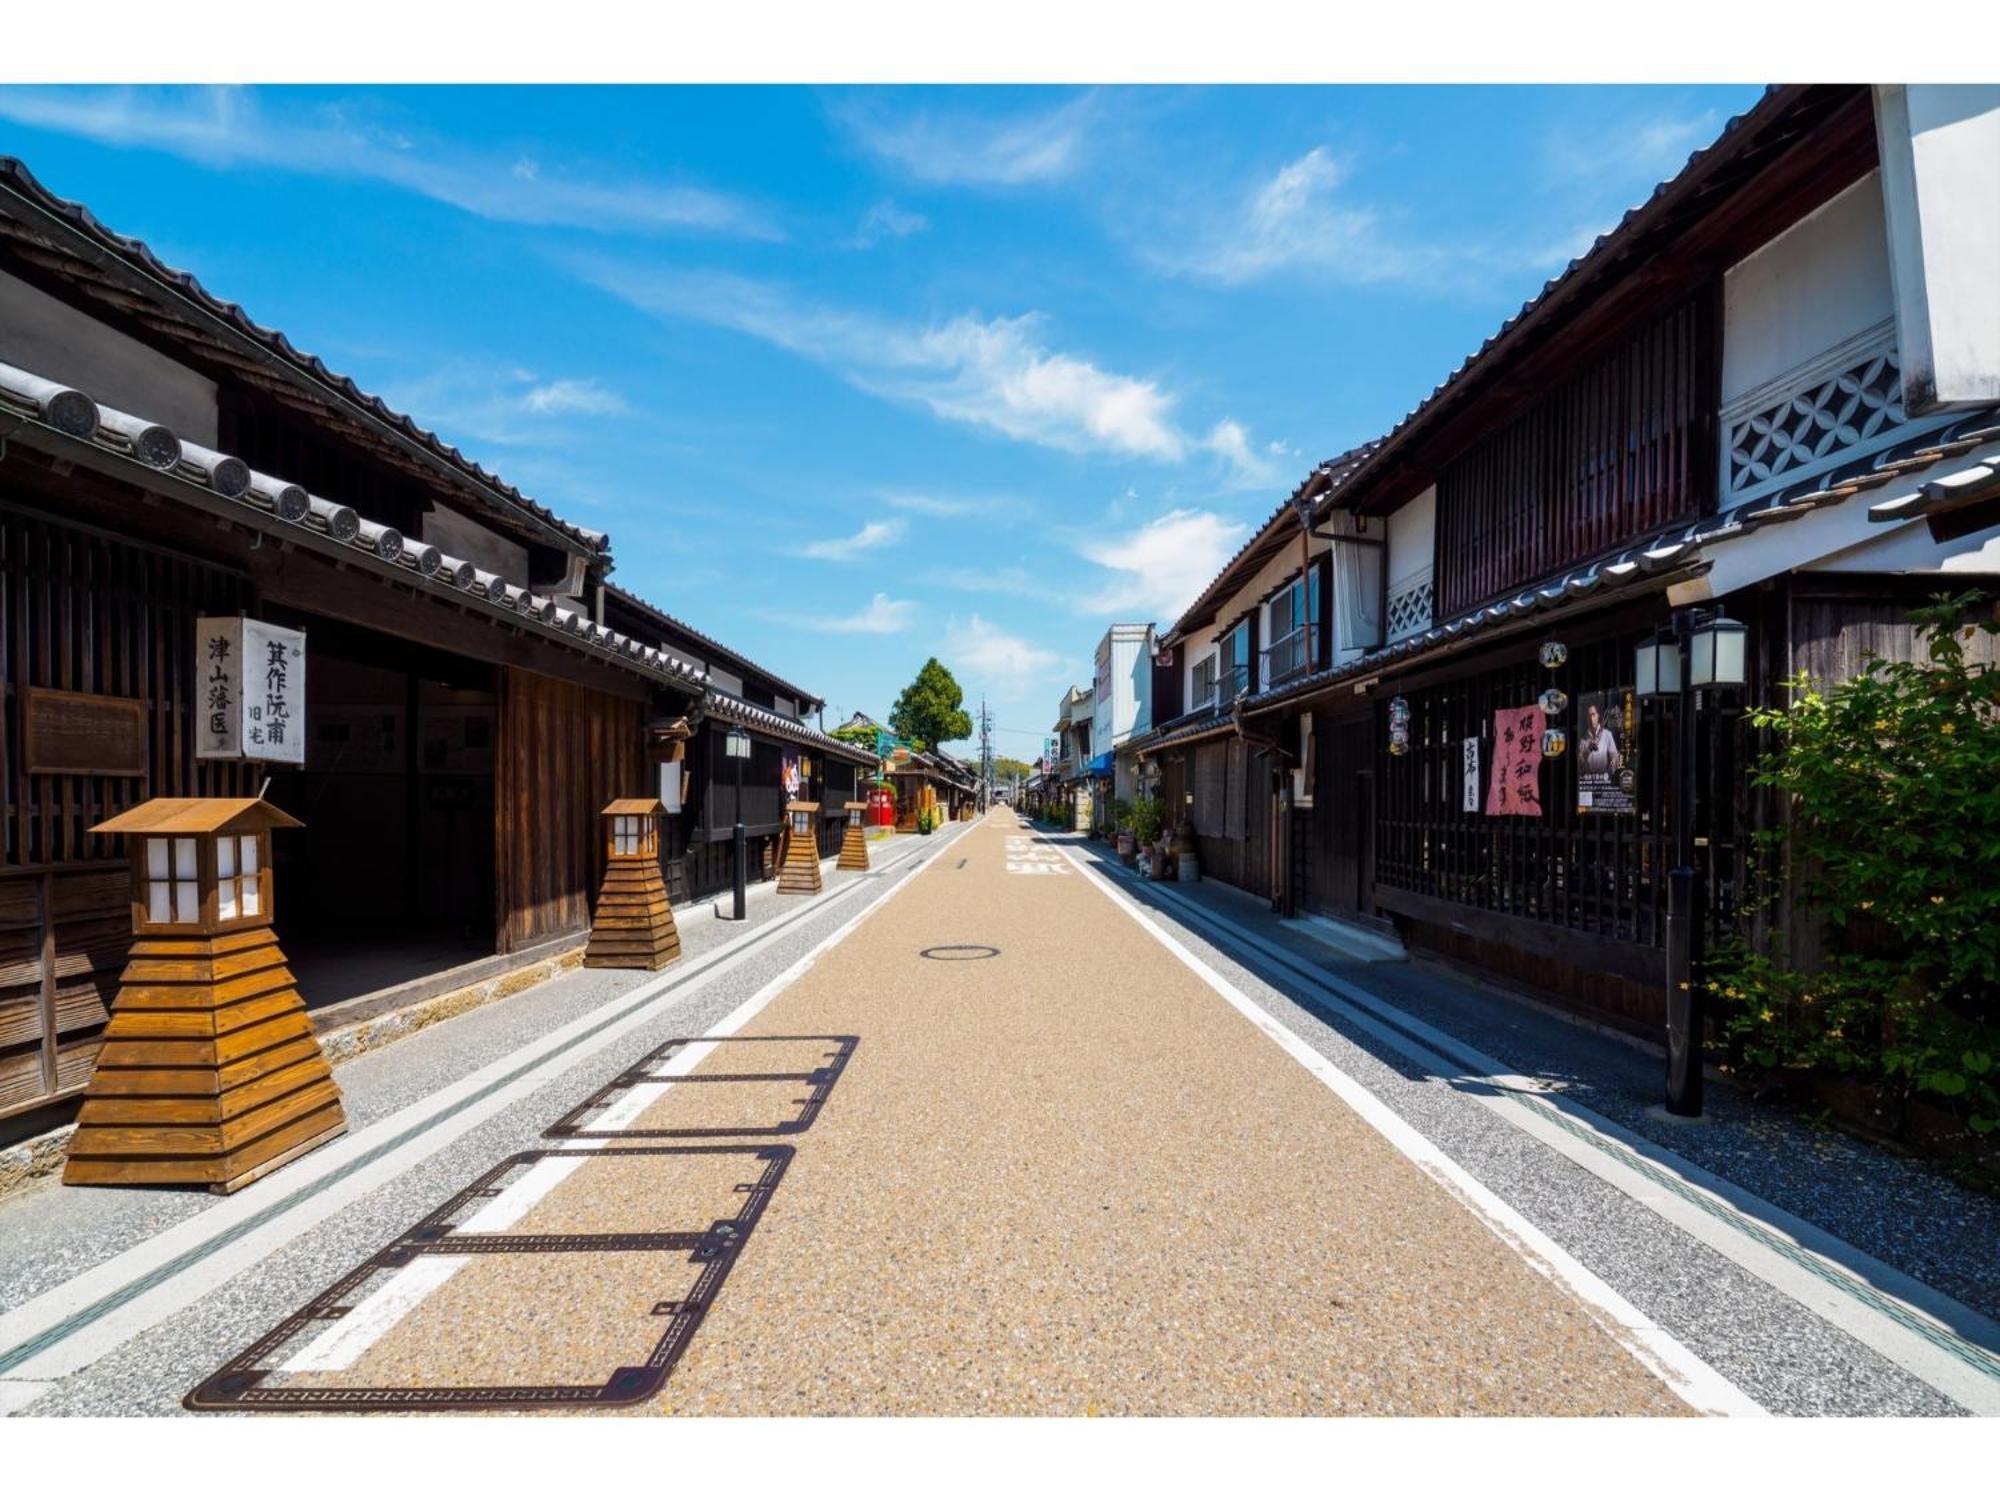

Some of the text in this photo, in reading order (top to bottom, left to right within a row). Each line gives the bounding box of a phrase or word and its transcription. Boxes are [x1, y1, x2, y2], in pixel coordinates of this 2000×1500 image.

[208, 637, 232, 734] 津山藩医
[248, 706, 265, 745] 旧宅
[266, 640, 290, 745] 箕作阮甫
